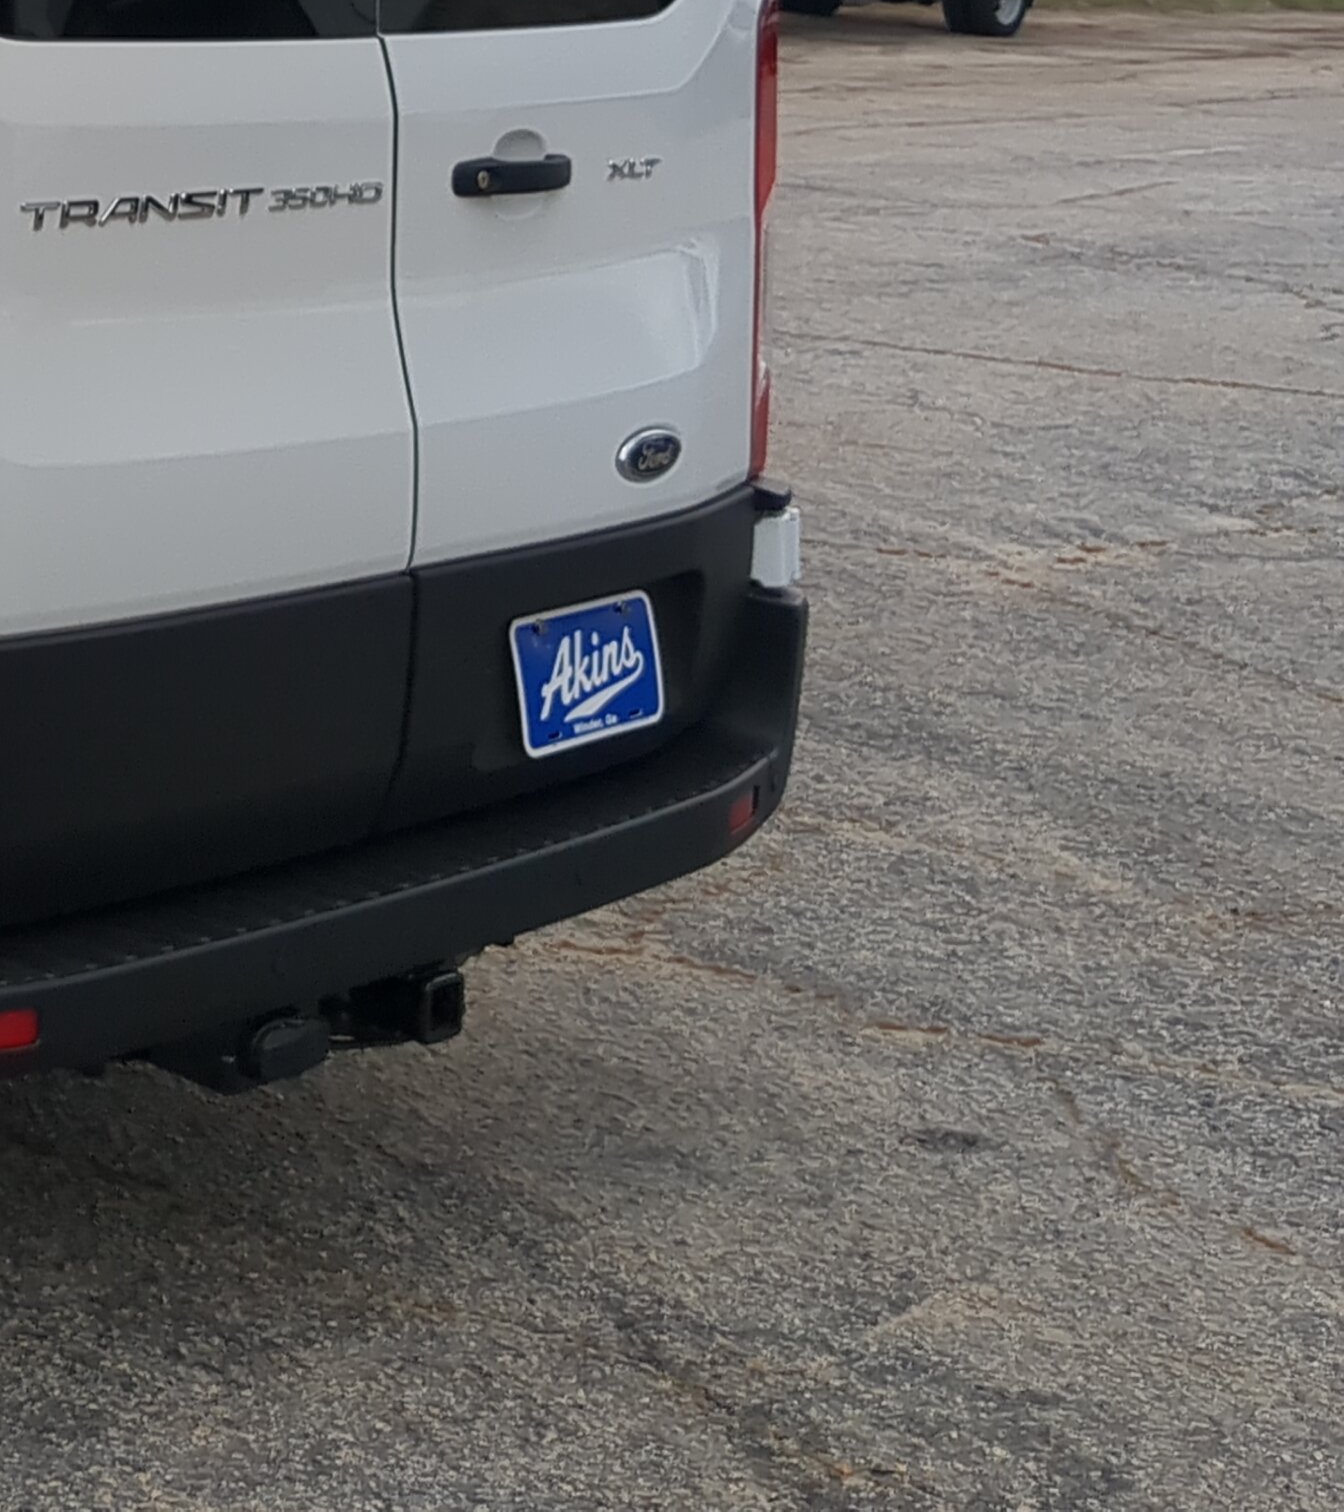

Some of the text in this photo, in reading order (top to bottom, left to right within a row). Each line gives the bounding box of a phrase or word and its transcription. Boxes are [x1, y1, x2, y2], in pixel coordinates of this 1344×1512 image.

[606, 158, 662, 181] XLT
[20, 181, 384, 232] TRANSIT 350HD
[540, 625, 644, 722] Akins
